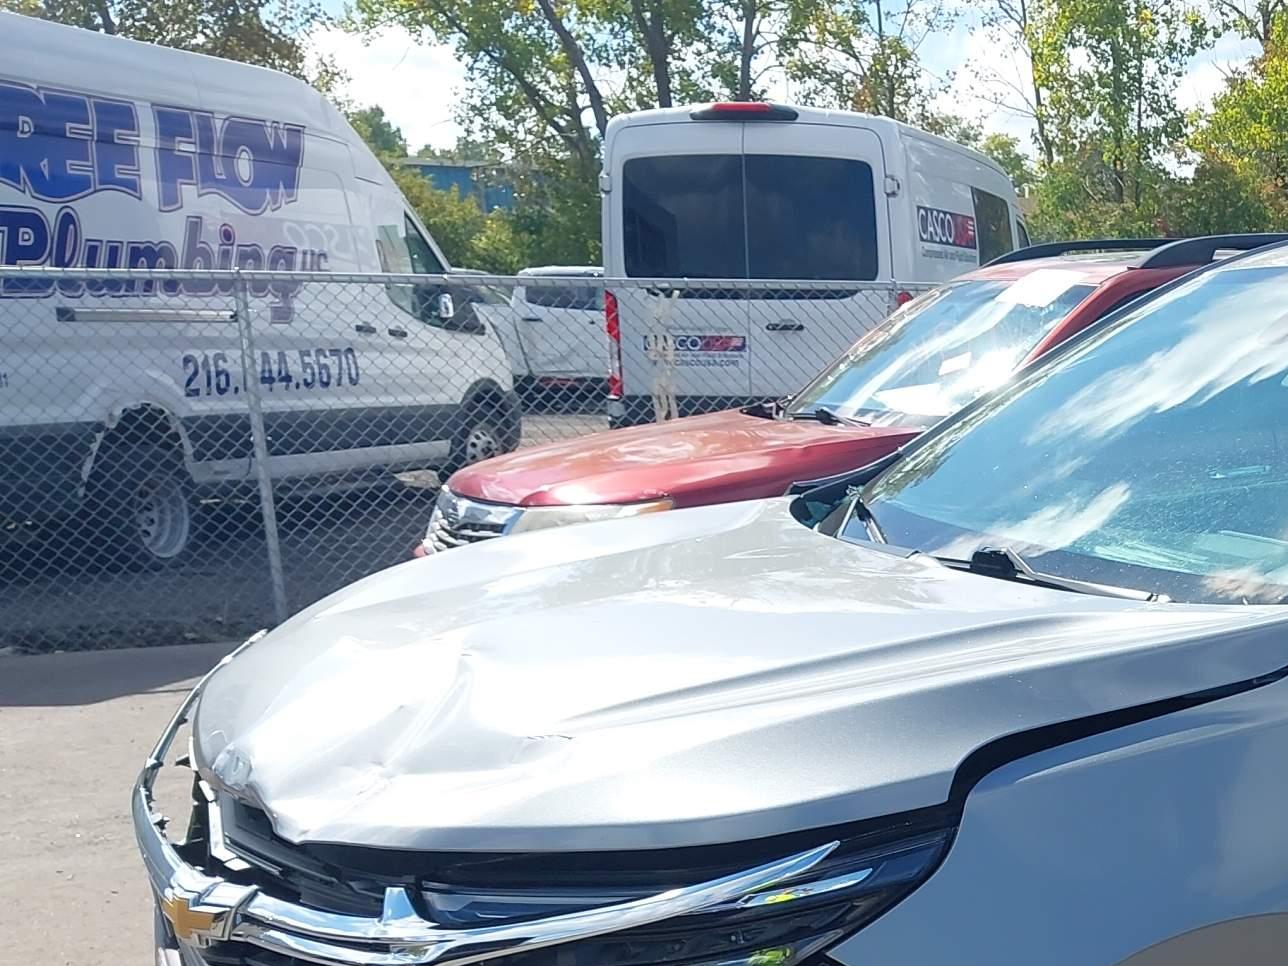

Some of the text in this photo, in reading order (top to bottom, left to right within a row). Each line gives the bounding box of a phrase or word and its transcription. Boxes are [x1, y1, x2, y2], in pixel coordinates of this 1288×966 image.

[0, 79, 306, 216] REE FLOW
[0, 204, 303, 324] Plumbing
[182, 347, 360, 398] 216.44.5670
